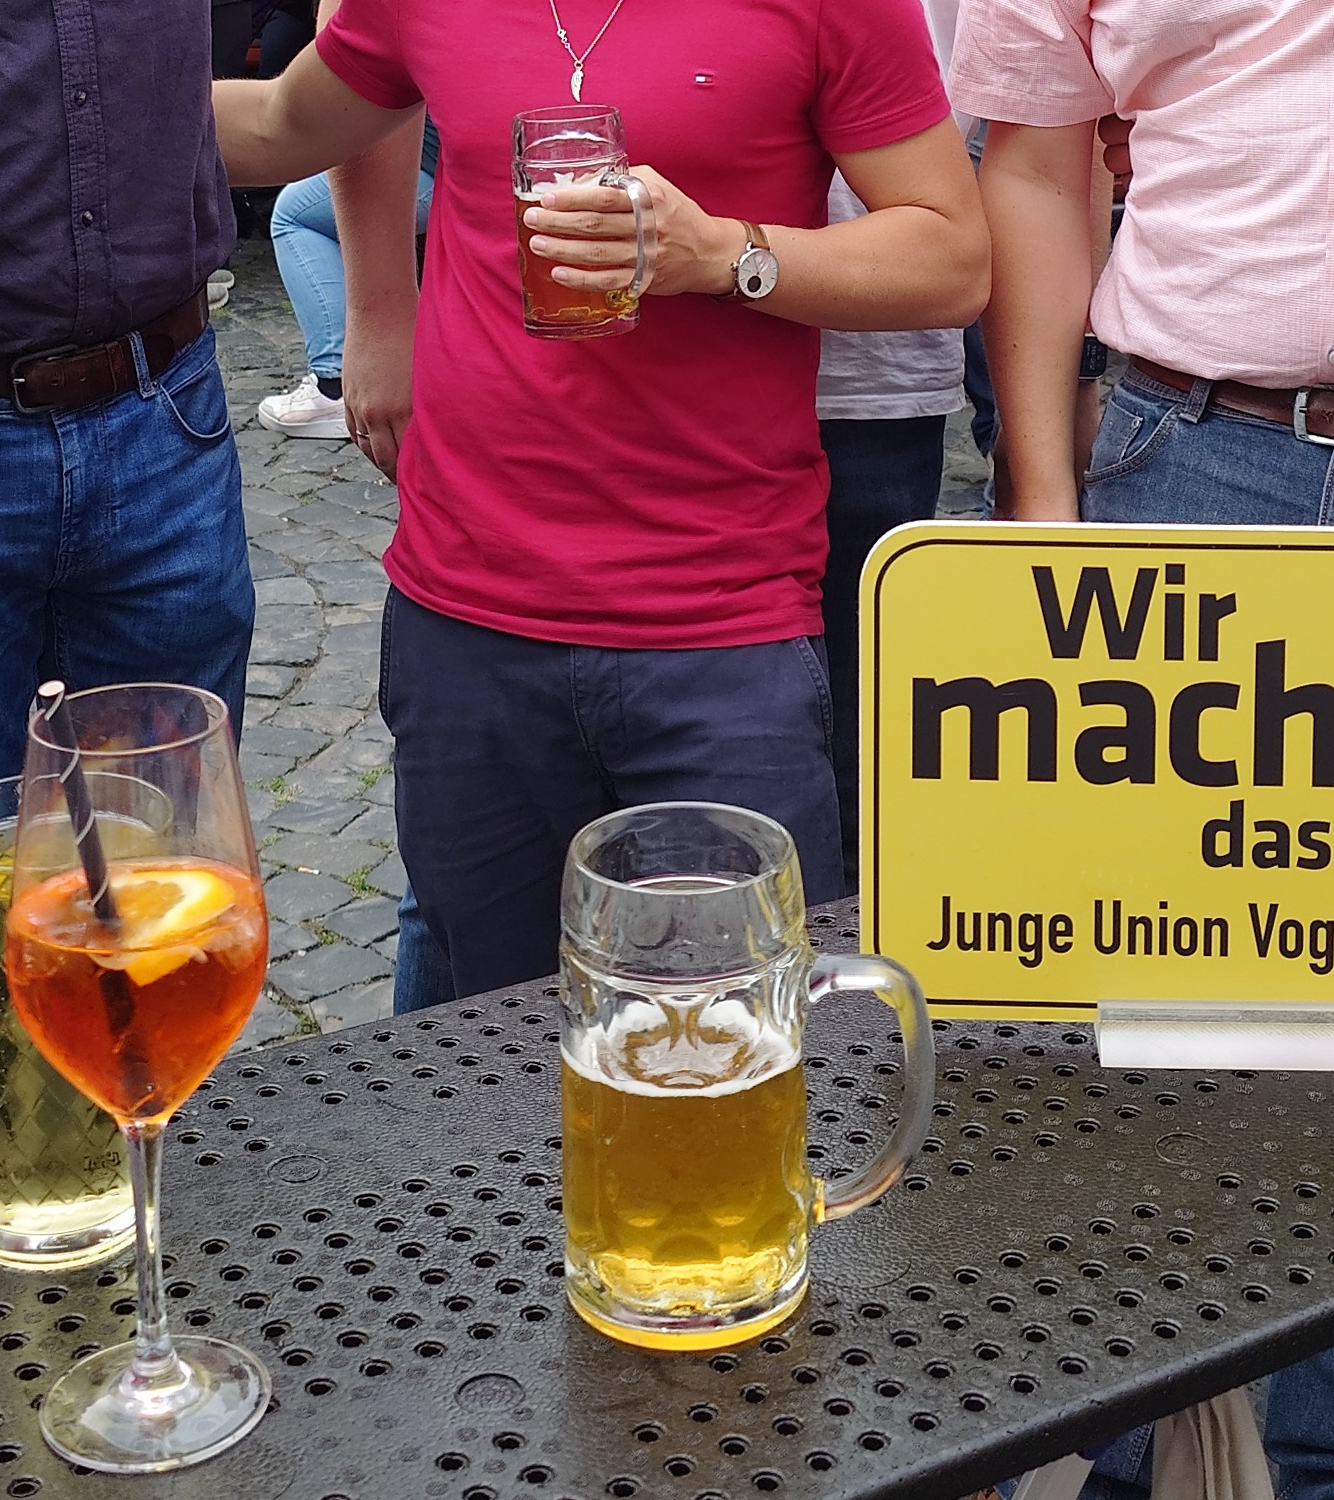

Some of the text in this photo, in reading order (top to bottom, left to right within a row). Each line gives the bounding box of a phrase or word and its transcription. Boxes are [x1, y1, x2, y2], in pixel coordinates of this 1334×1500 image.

[1031, 563, 1237, 662] Wir
[926, 896, 1074, 968] Junge
[1092, 899, 1229, 959] Union
